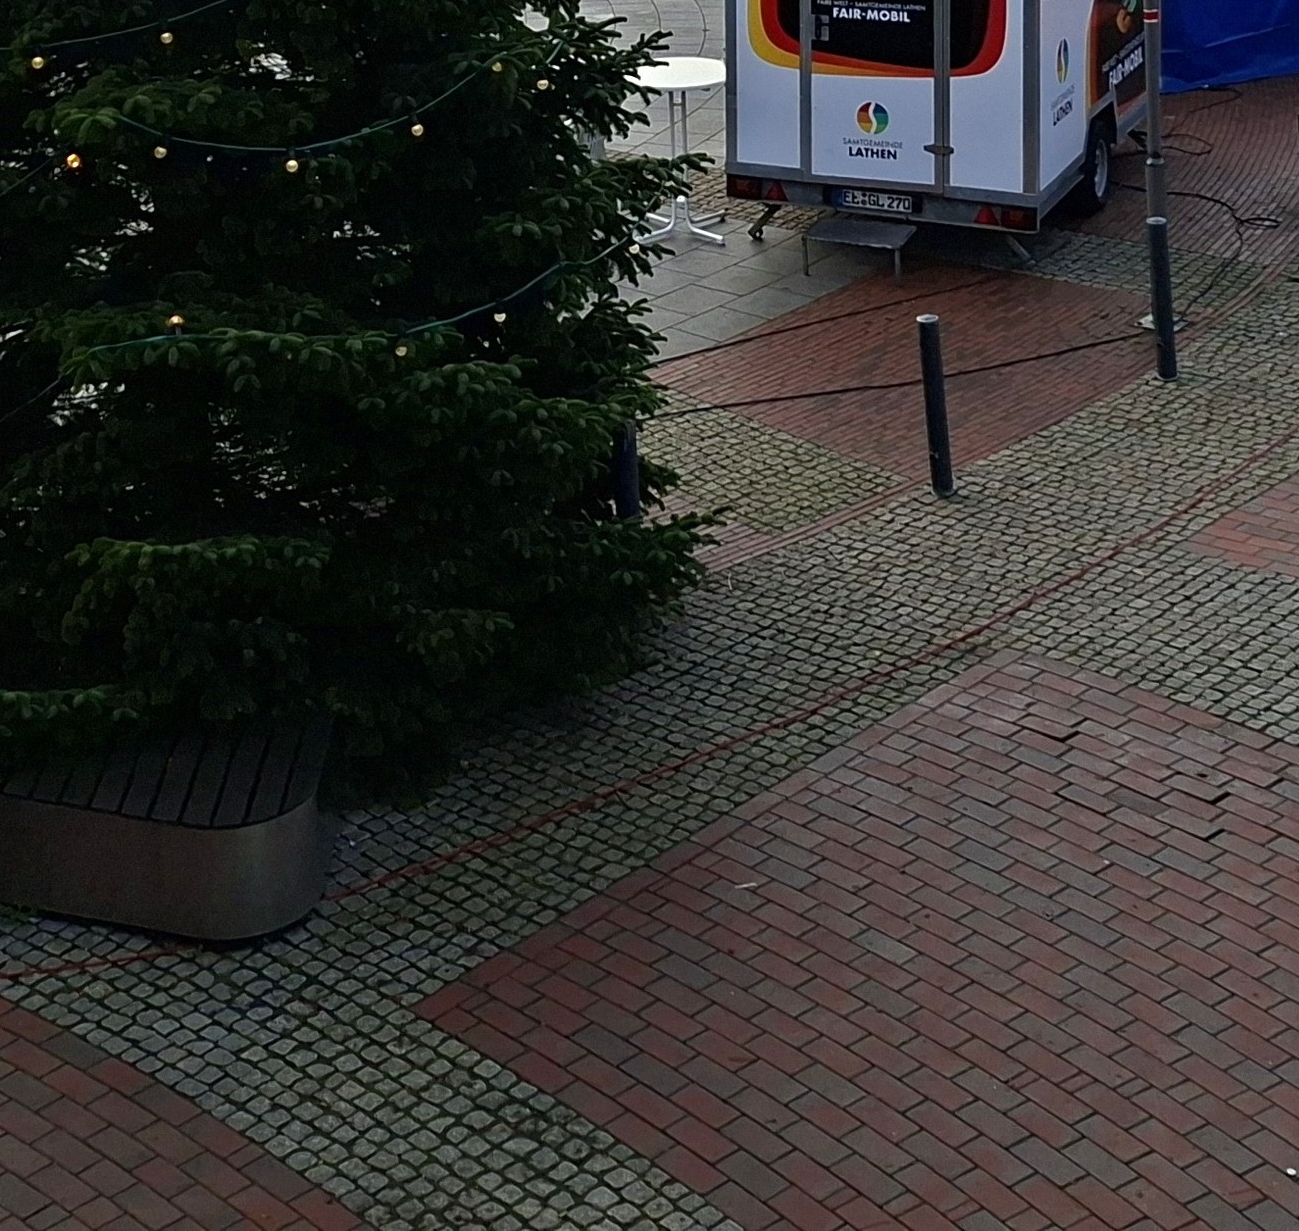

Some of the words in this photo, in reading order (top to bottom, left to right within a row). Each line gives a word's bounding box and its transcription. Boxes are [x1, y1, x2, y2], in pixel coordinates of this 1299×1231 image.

[833, 7, 911, 23] FAIR-MOBIL
[843, 137, 903, 149] SAMTGEMEINDE
[849, 147, 897, 160] LATHEN
[868, 193, 885, 207] GL
[887, 196, 911, 210] 270
